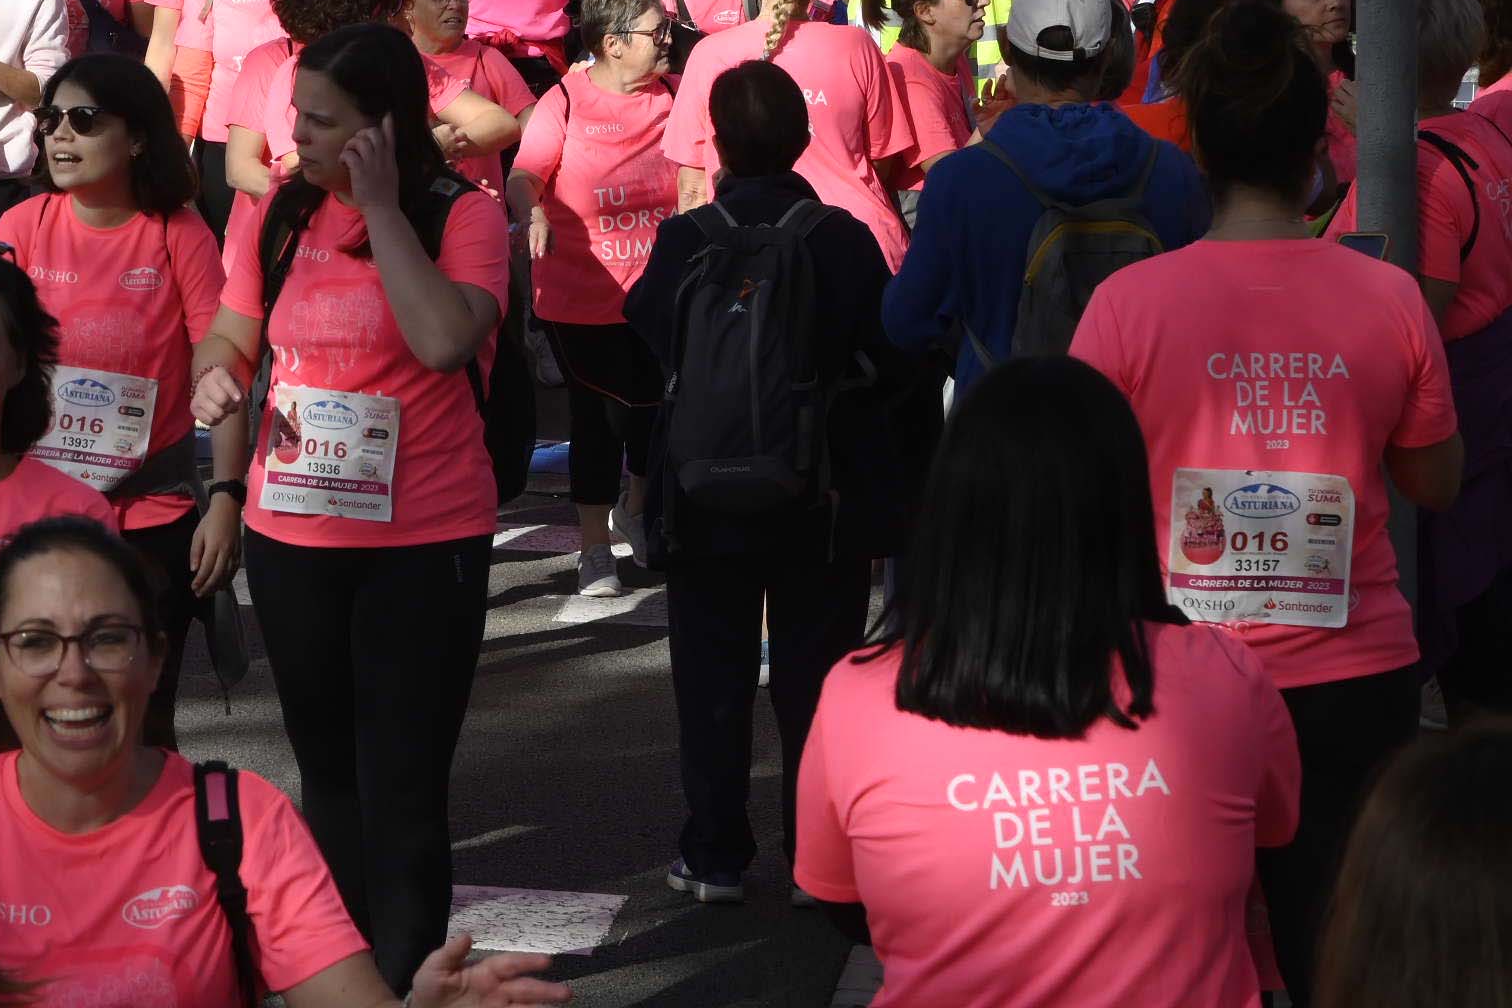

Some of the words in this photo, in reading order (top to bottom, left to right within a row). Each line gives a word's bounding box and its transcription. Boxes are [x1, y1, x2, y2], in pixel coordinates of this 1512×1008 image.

[802, 90, 828, 106] RA
[585, 123, 625, 136] OYSHO
[593, 185, 626, 208] TU
[296, 245, 331, 264] SHO
[600, 240, 654, 261] SUM
[1206, 352, 1350, 381] CARRERA
[63, 386, 111, 404] ASTURIANA
[1235, 381, 1271, 407] DE
[1282, 381, 1322, 407] LA
[59, 413, 105, 434] 016
[306, 409, 354, 425] ASTURIANA
[1228, 409, 1328, 437] MUJER
[61, 435, 96, 450] 13937
[304, 438, 348, 459] 016
[1265, 439, 1290, 450] 2023
[62, 450, 74, 459] DE
[74, 452, 84, 462] LA
[85, 454, 112, 465] MUJER
[91, 471, 122, 484] Santan
[307, 462, 341, 476] 13936
[278, 475, 307, 485] CARRERA
[308, 478, 318, 486] DE
[319, 480, 329, 488] LA
[331, 481, 358, 491] MUJER
[272, 491, 306, 504] OYSHO
[338, 497, 382, 511] Santander
[1229, 494, 1295, 511] ASTURIANA
[1307, 494, 1342, 504] SUMA
[1230, 531, 1289, 553] 016
[1234, 559, 1280, 572] 33157
[1188, 578, 1235, 588] CARRERA
[1237, 578, 1253, 588] DE
[1254, 578, 1267, 588] LA
[1268, 580, 1304, 589] MUJER
[1306, 581, 1331, 590] 2023
[1182, 596, 1236, 612] OYSHO
[1278, 599, 1334, 615] Santander
[946, 757, 1172, 812] CARRERA
[992, 808, 1054, 850] DE
[1072, 803, 1131, 843] LA
[989, 843, 1143, 890] MUJER
[1050, 891, 1089, 907] 2023
